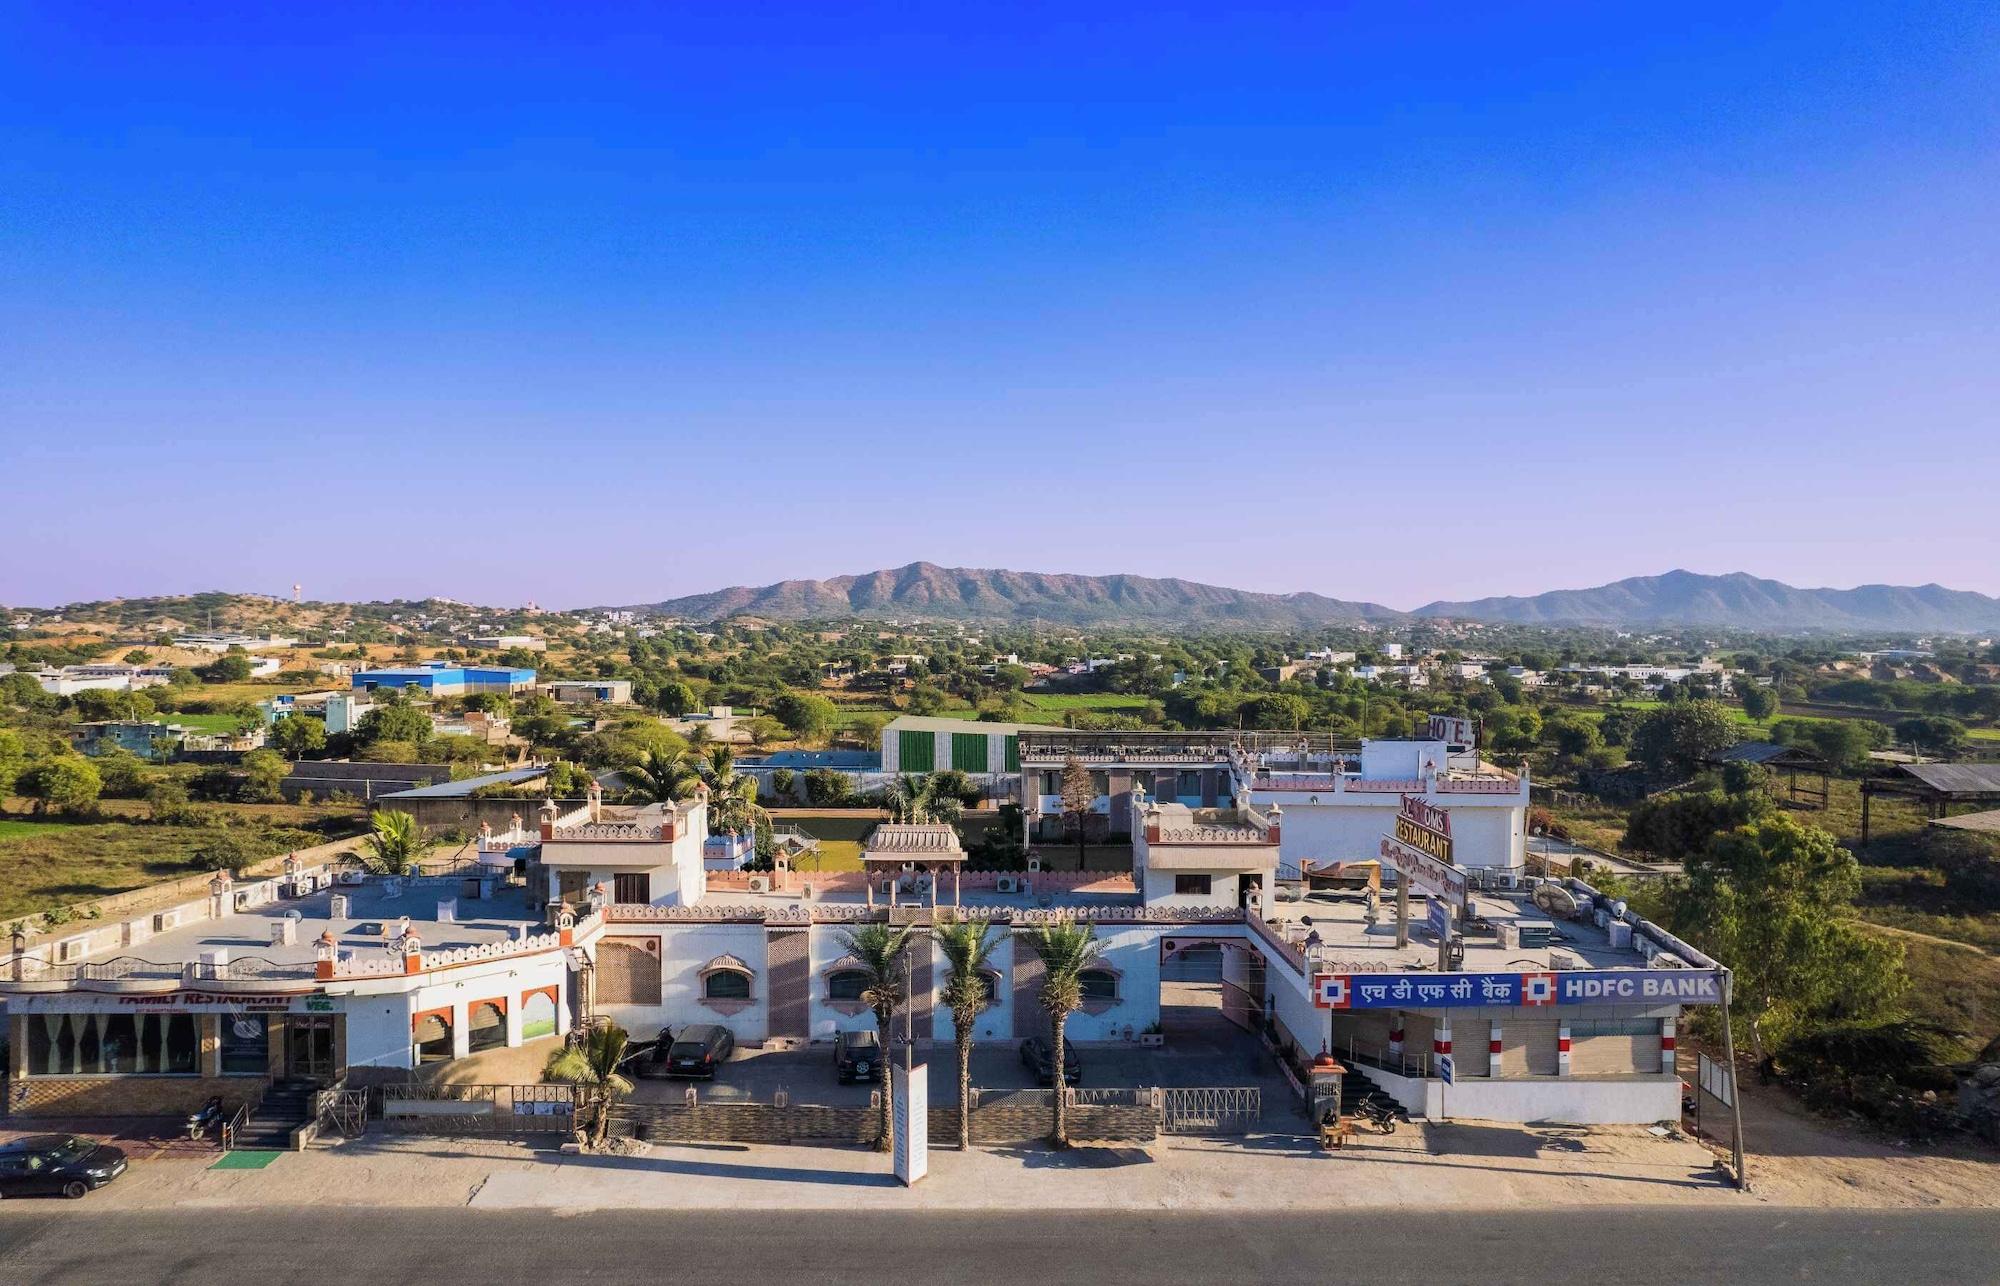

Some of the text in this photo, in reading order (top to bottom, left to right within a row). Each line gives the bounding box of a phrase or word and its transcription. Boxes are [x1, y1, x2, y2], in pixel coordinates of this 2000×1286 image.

[1427, 717, 1472, 745] HOE
[1396, 818, 1449, 861] RESTAURANT
[1361, 976, 1511, 1003] एच डी एफ सी बैंक
[1566, 978, 1715, 997] HDFC BANK
